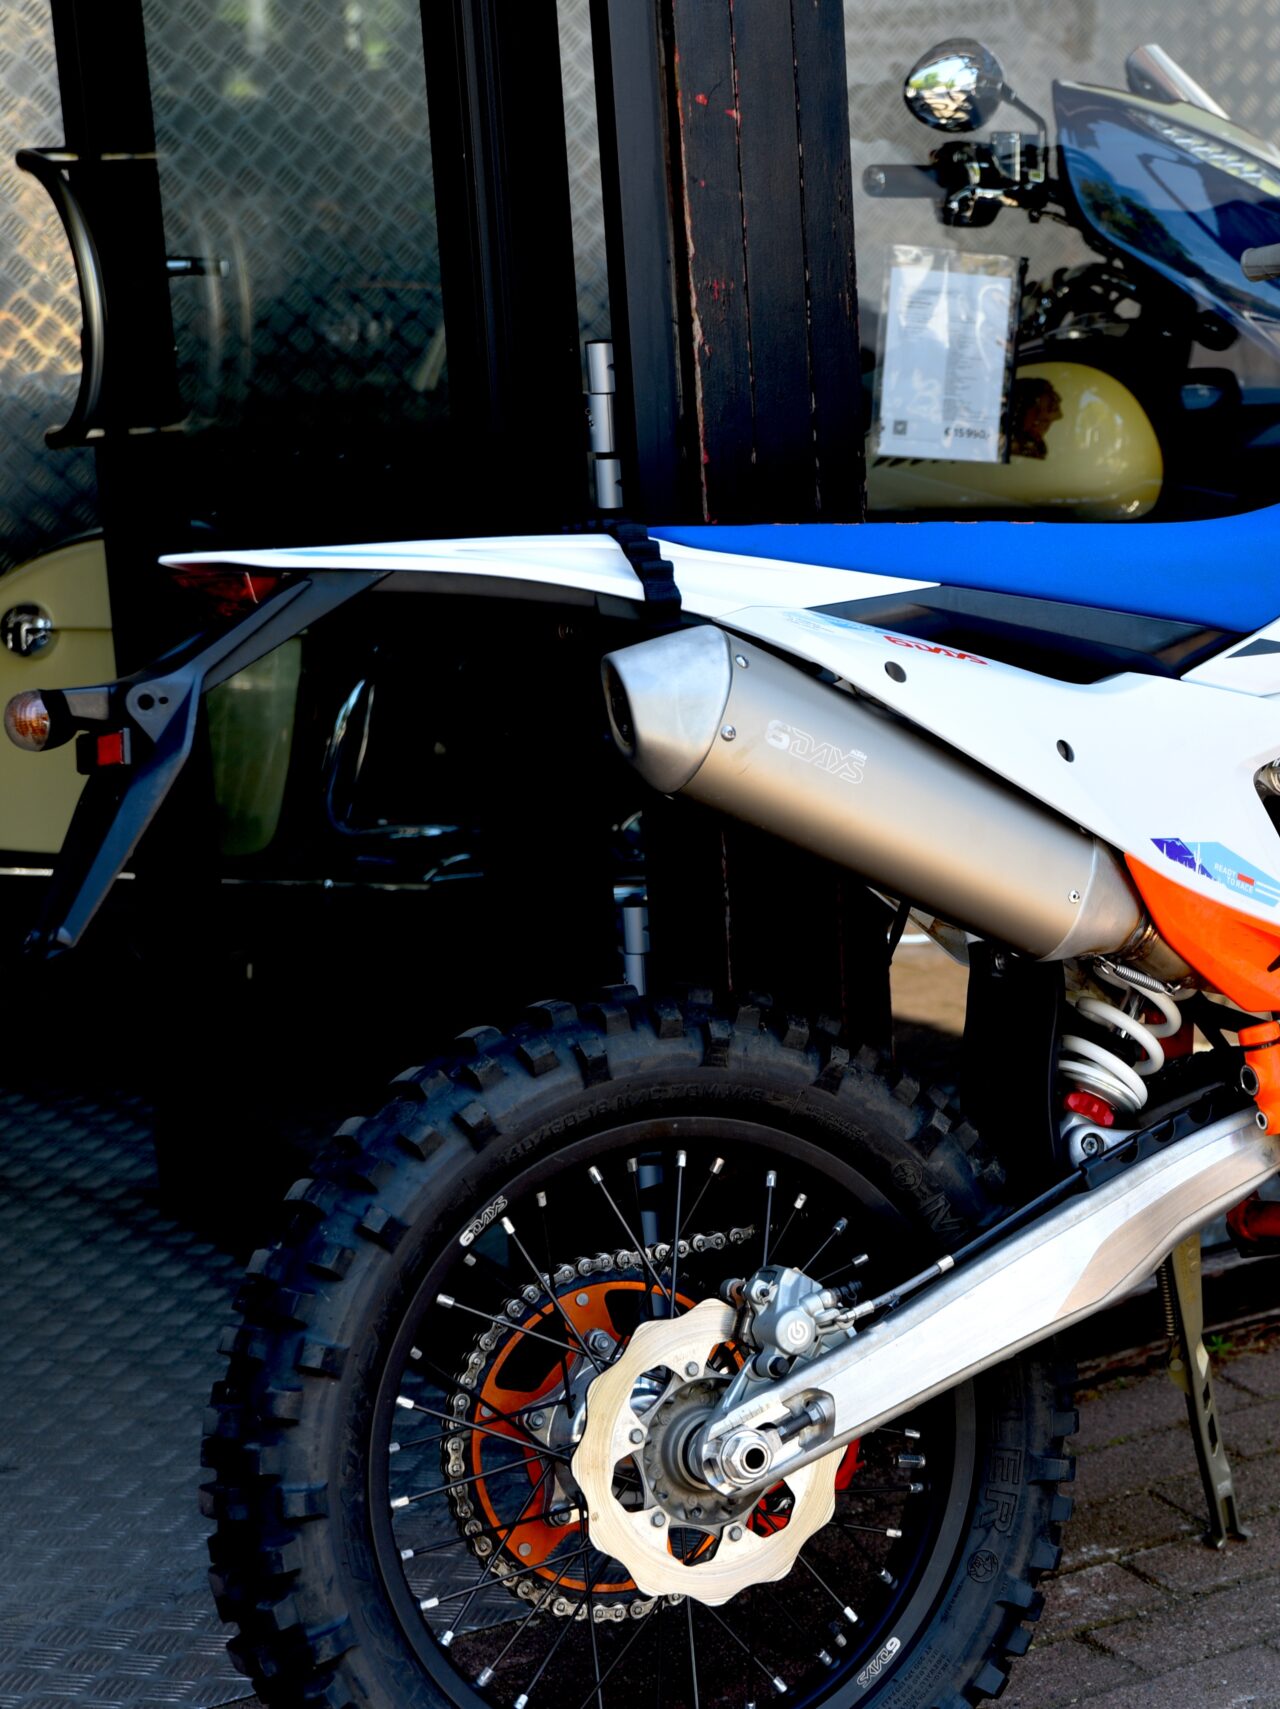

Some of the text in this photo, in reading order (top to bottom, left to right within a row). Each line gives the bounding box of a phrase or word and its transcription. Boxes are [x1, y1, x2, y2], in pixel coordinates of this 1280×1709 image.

[882, 634, 989, 666] 6DAYS
[764, 719, 865, 784] 6DAYS
[1213, 862, 1238, 877] READY
[1236, 878, 1254, 893] RACE
[458, 1194, 509, 1248] 6DAYS
[856, 1636, 901, 1689] 6DAYS
